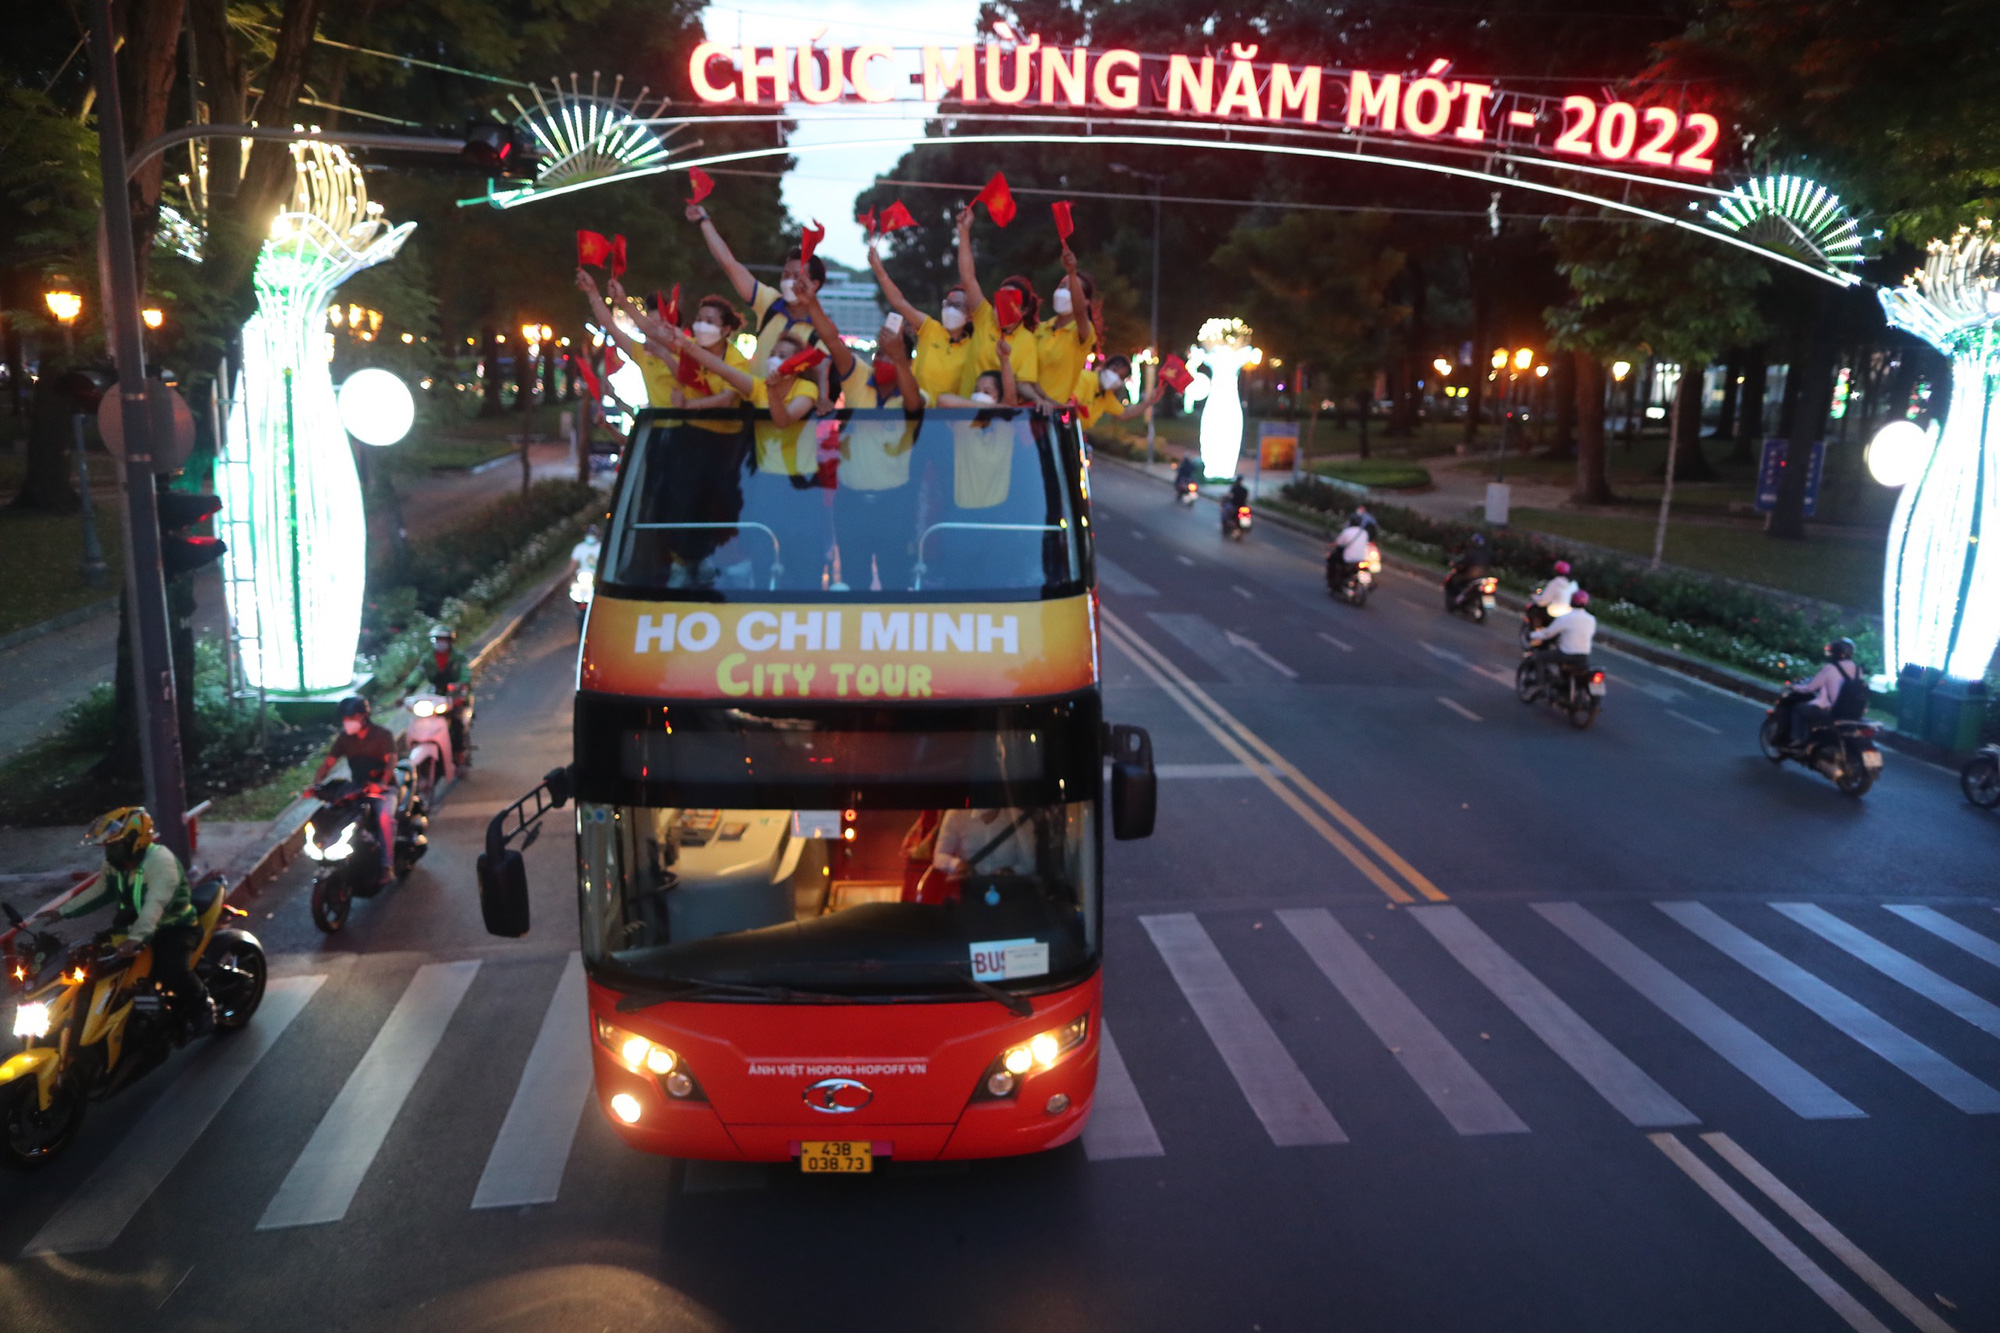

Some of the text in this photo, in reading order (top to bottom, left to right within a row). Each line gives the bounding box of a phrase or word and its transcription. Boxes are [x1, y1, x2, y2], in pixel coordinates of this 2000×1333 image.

[688, 27, 895, 103] CHÚC
[922, 21, 1142, 109] MỪNG
[1166, 43, 1322, 122] NĂM
[1346, 58, 1492, 141] MỚI
[1554, 95, 1721, 174] 2022
[634, 611, 1020, 654] HO CHI MINH
[830, 663, 933, 698] TOUR
[907, 1063, 927, 1075] VN
[821, 1143, 851, 1157] 43B
[808, 1157, 865, 1171] 038.73
